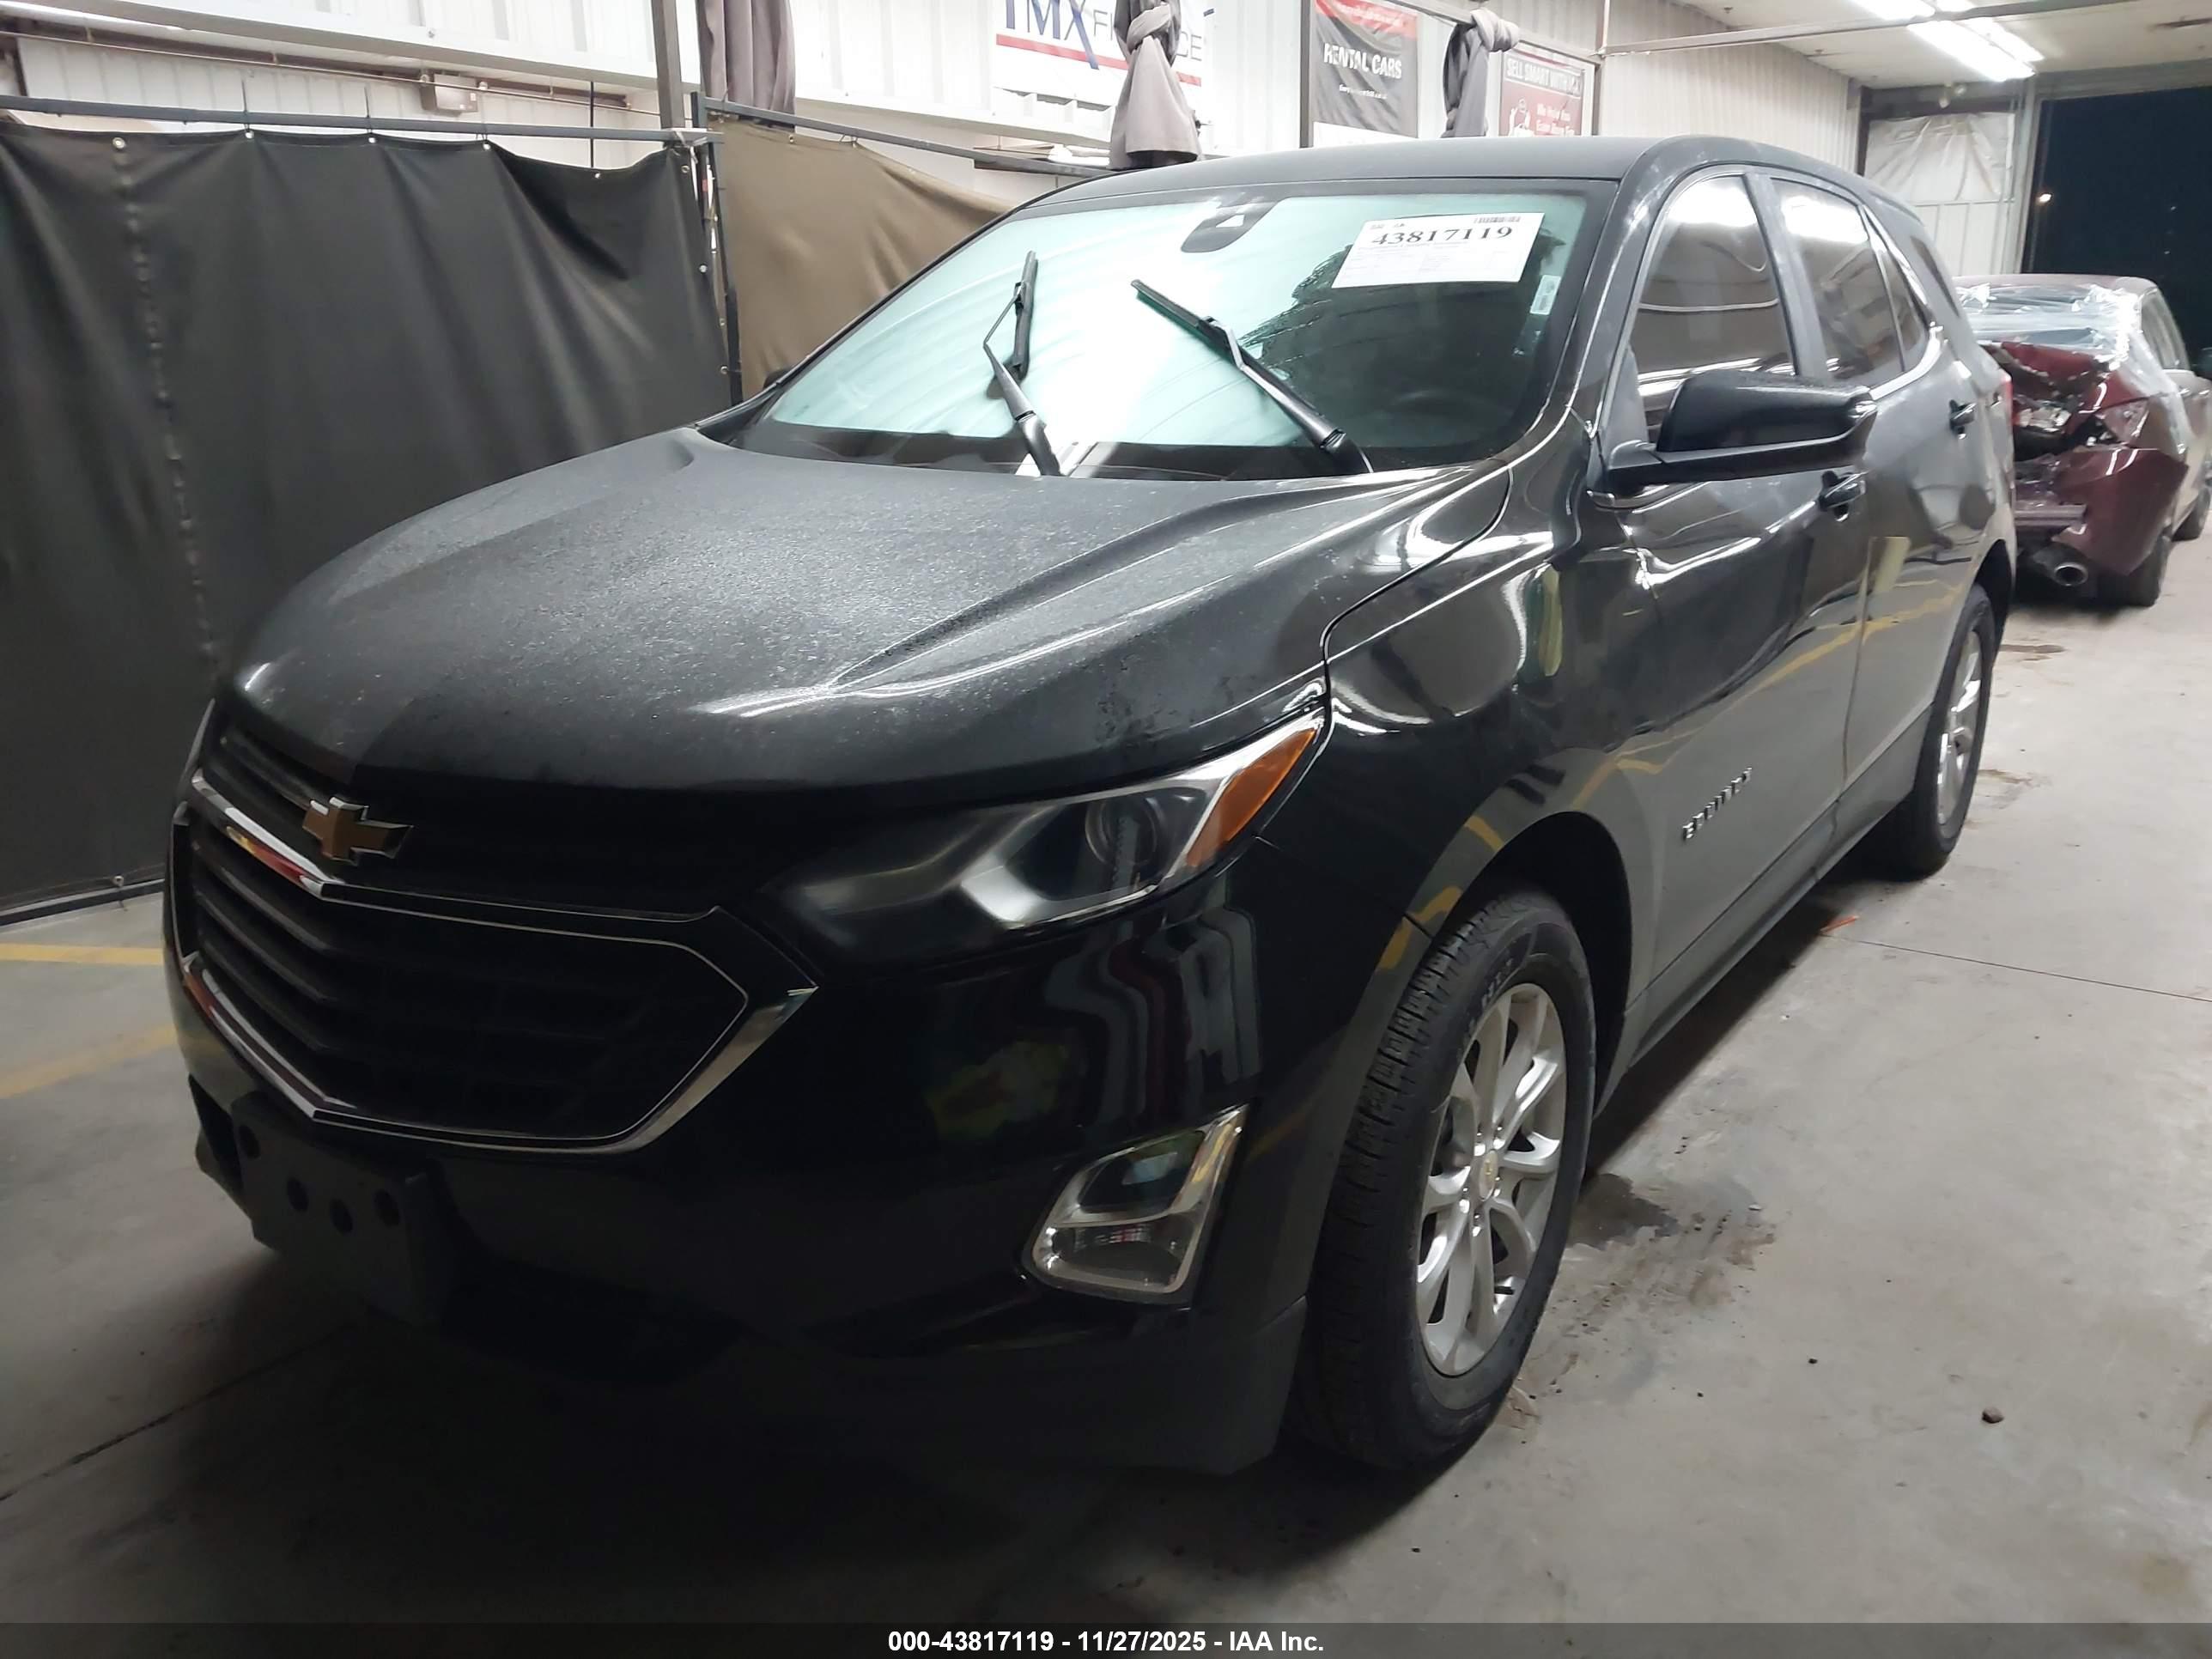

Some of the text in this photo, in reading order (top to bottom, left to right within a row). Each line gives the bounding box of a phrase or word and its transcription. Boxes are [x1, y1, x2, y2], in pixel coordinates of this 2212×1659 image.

[1323, 42, 1402, 79] RENTAL CARS
[1371, 226, 1513, 245] 43817119
